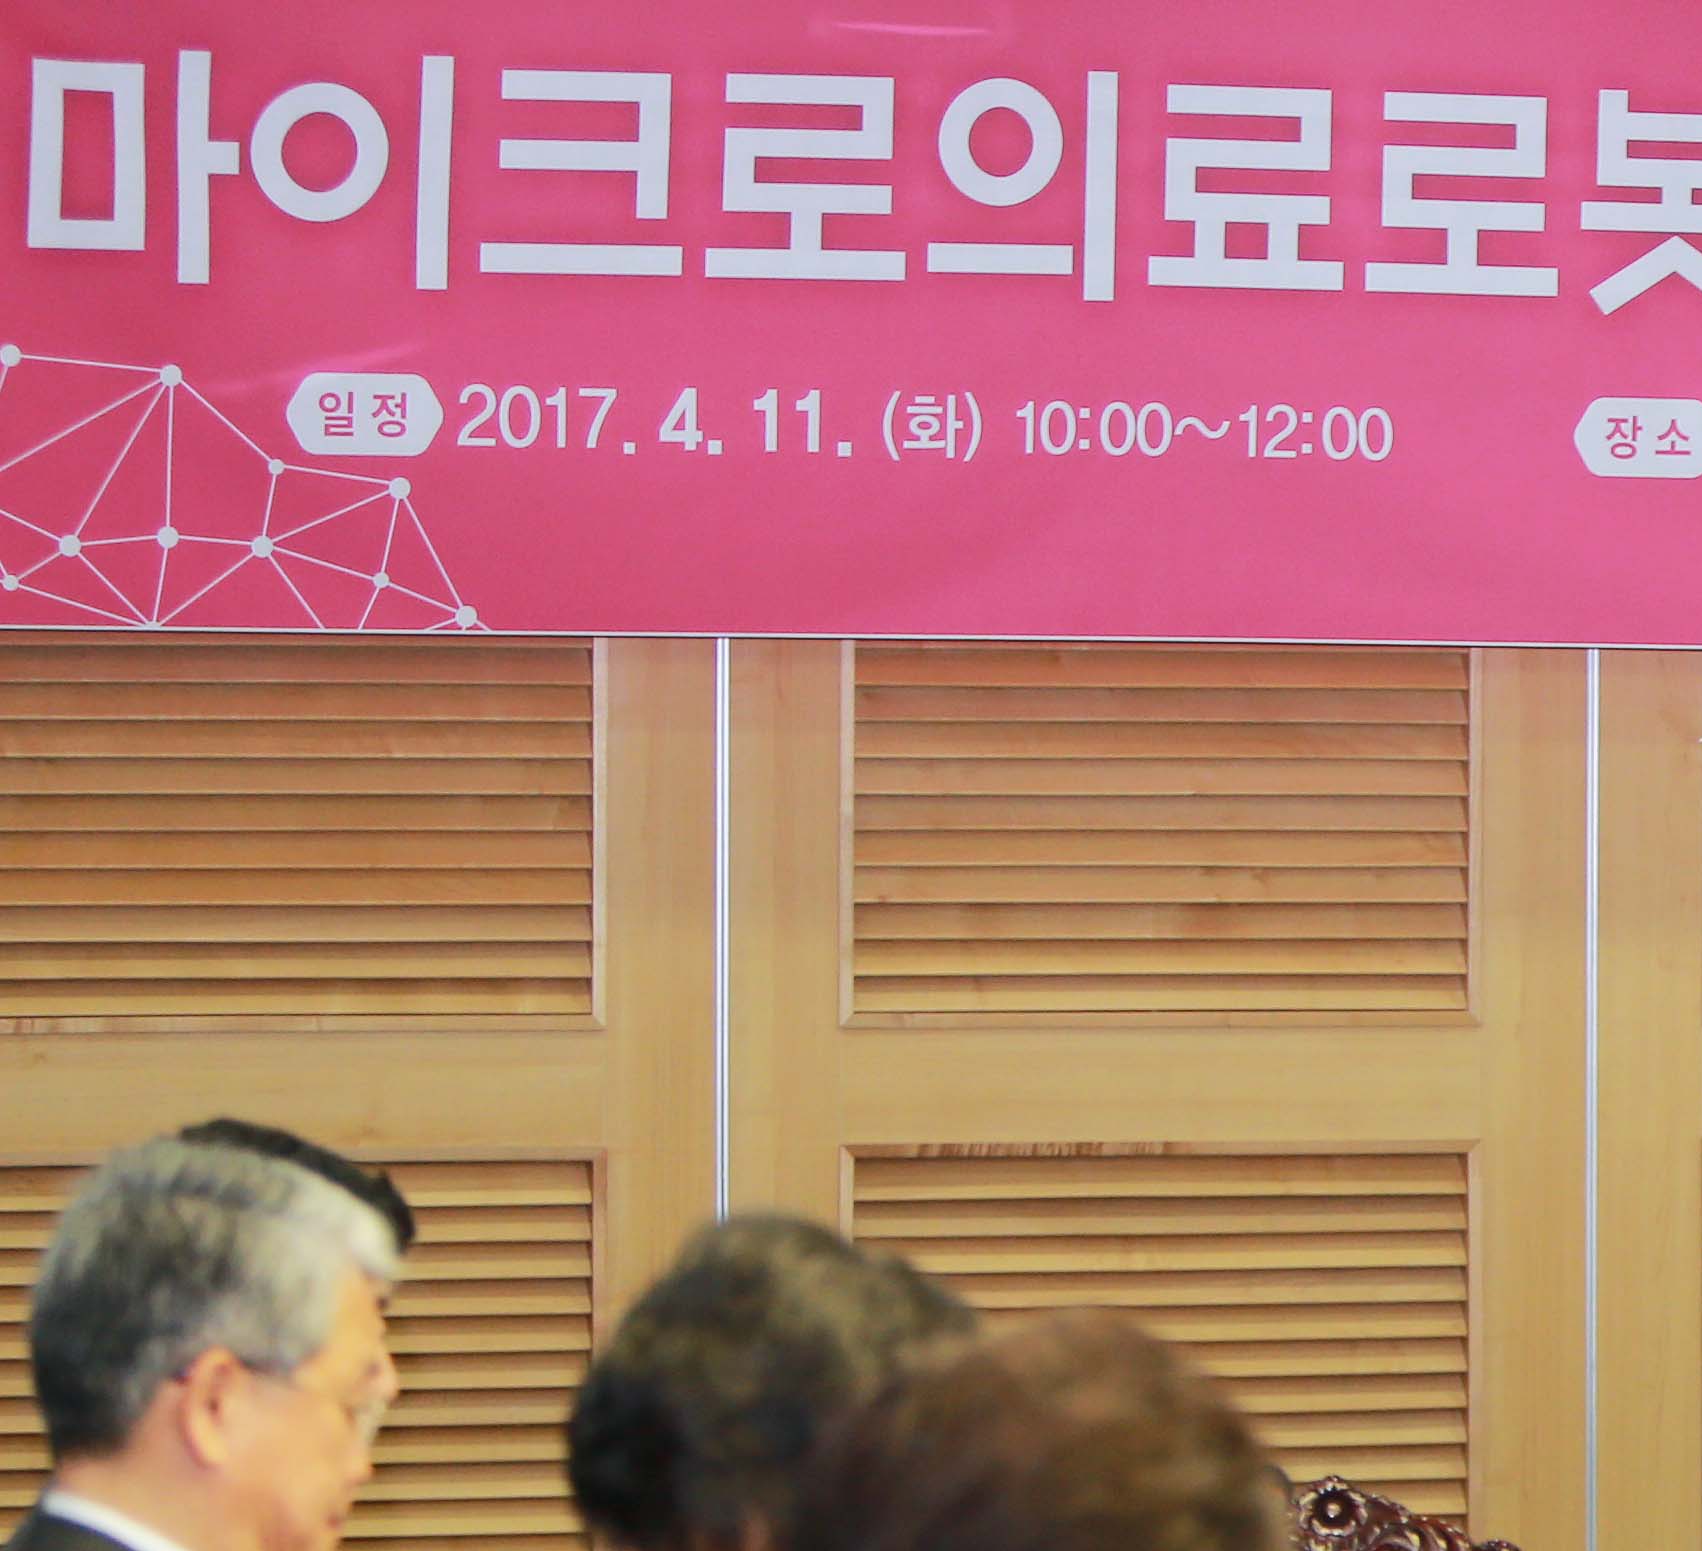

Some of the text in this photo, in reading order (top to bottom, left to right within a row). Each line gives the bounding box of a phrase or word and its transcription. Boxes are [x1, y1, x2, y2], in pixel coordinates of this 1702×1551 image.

[318, 391, 408, 438] 일정
[457, 384, 1395, 462] 2017. 4. 11. (화) 10:00~12:00
[1605, 415, 1692, 459] 장소
